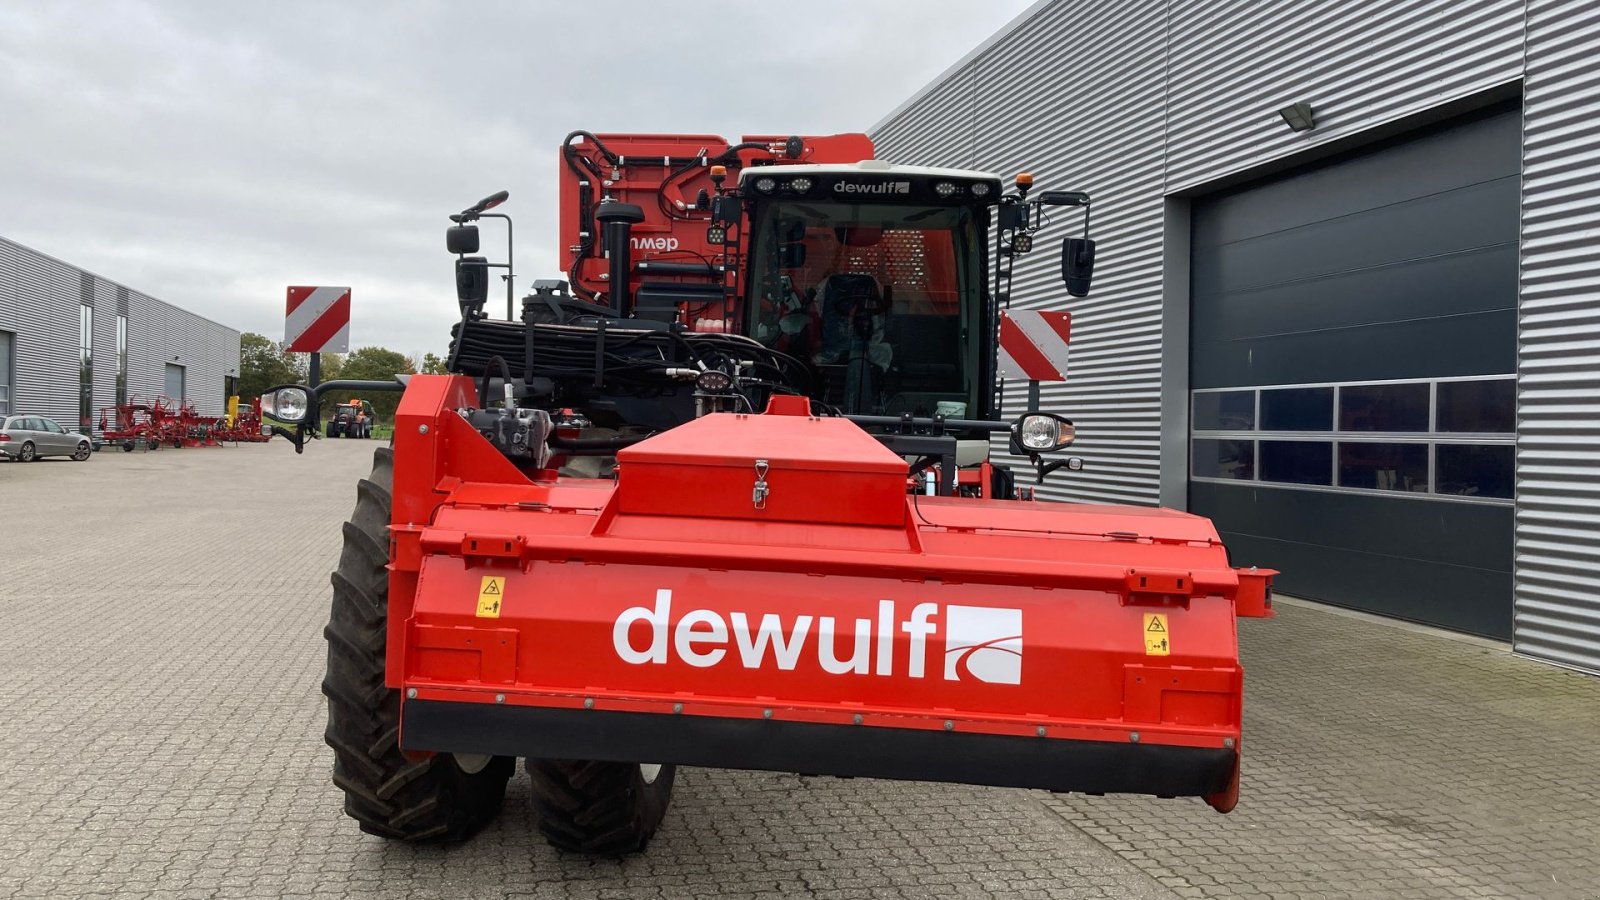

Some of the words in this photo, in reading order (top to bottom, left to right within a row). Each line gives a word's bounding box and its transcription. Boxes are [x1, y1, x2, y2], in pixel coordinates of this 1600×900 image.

[833, 180, 894, 193] dewulf
[630, 237, 679, 251] dewu
[612, 588, 938, 679] dewulf
